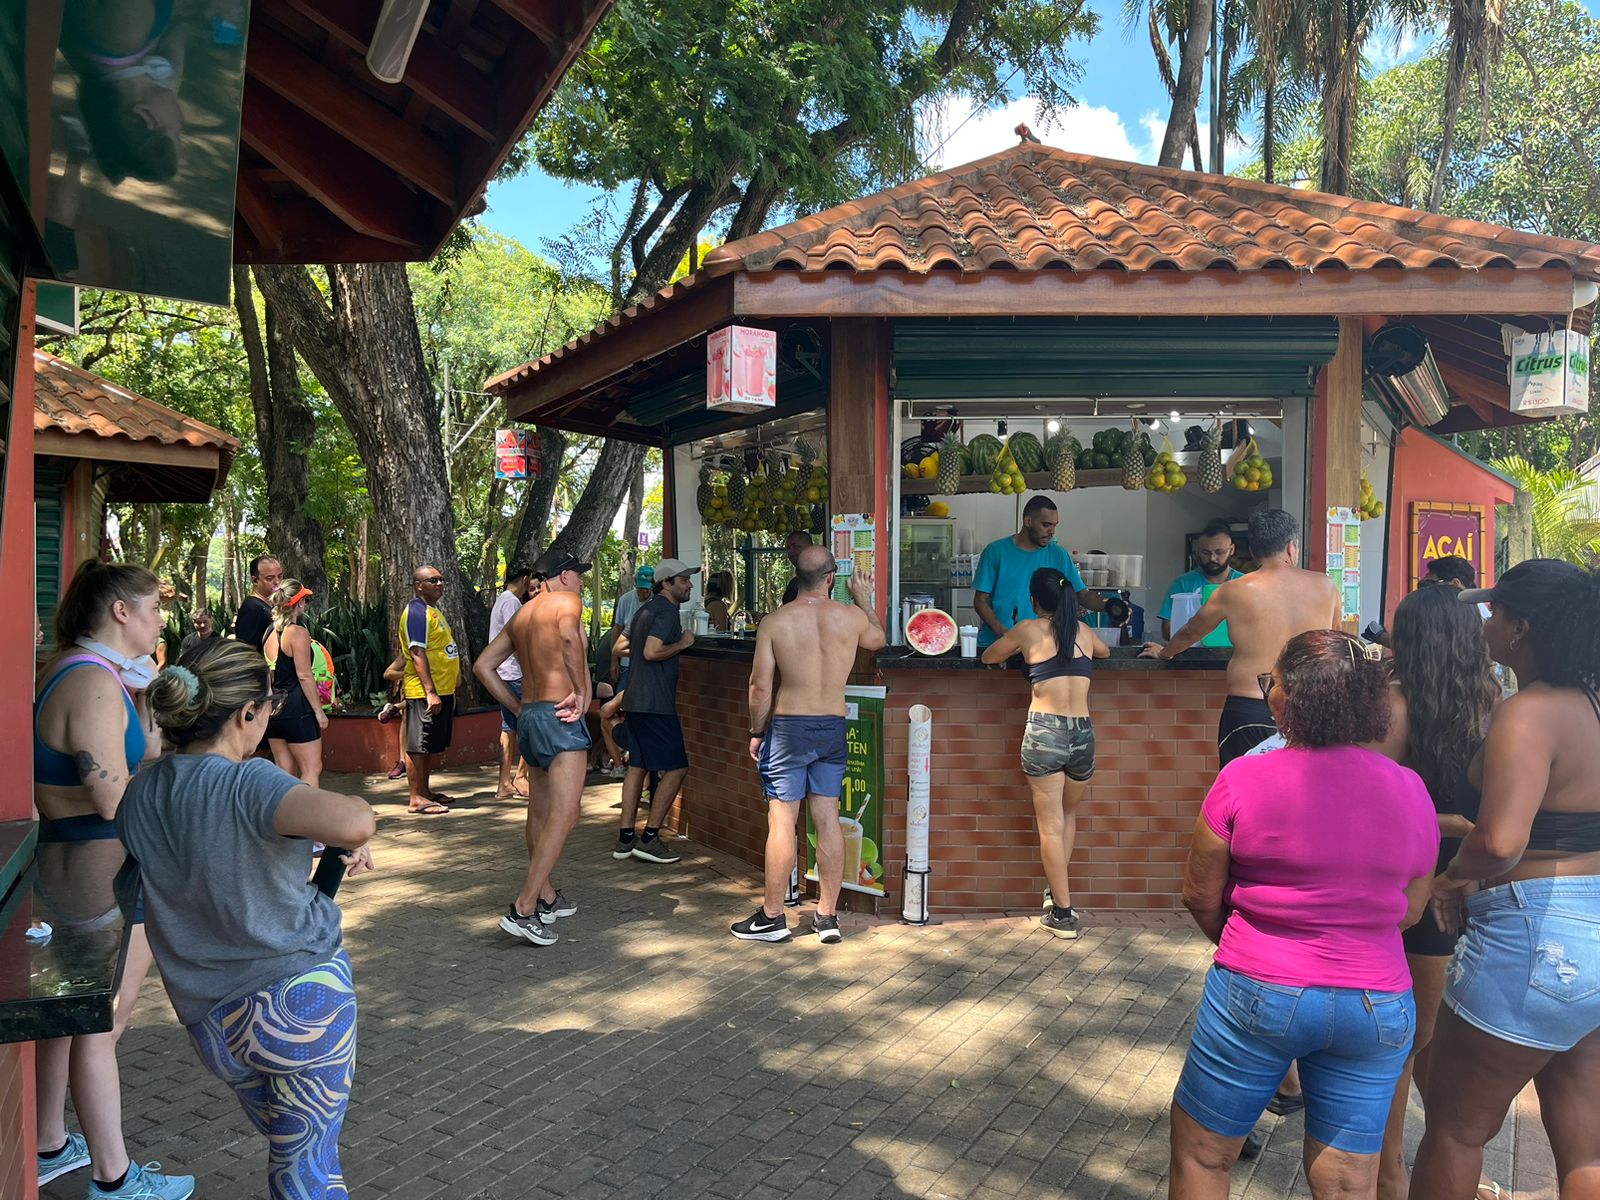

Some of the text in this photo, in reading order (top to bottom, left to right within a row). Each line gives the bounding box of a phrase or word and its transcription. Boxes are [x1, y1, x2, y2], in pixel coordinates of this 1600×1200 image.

[1516, 356, 1563, 372] Citrus
[1422, 532, 1474, 561] AÇAÍ
[847, 741, 868, 756] TEN
[526, 923, 543, 936] FILA
